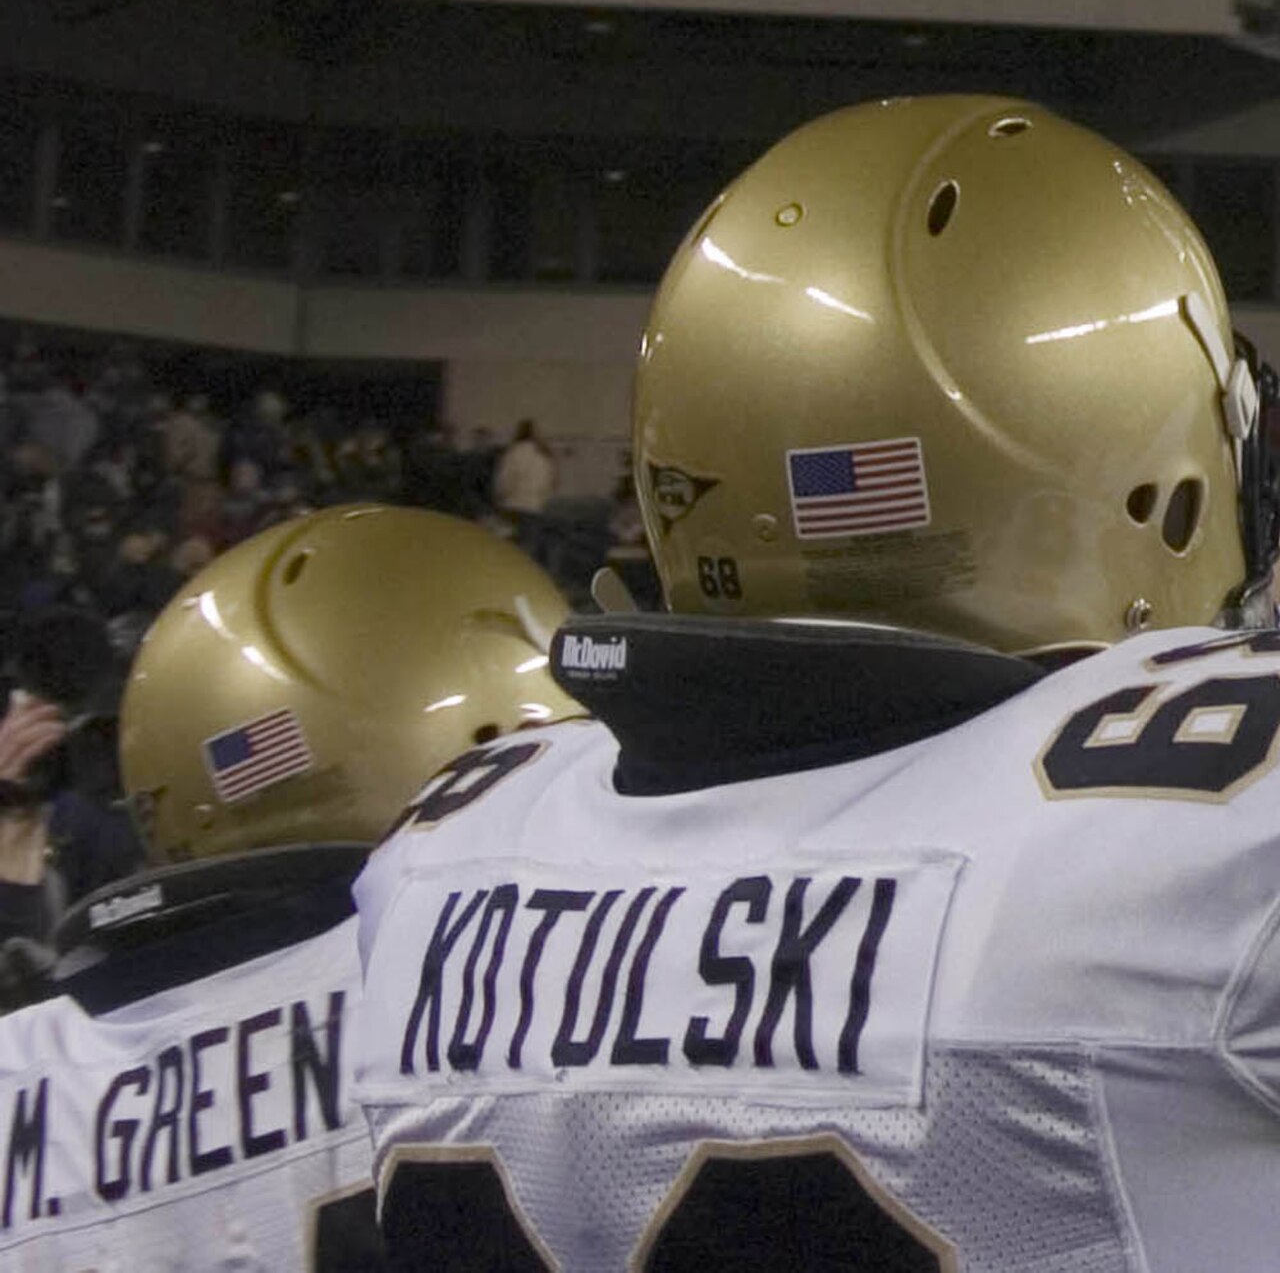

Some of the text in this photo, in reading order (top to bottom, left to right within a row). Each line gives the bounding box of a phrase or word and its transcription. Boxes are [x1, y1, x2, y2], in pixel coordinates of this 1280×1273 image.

[697, 555, 742, 602] 68
[401, 874, 898, 1076] KOTULSKI
[2, 990, 346, 1226] M. GREEN
